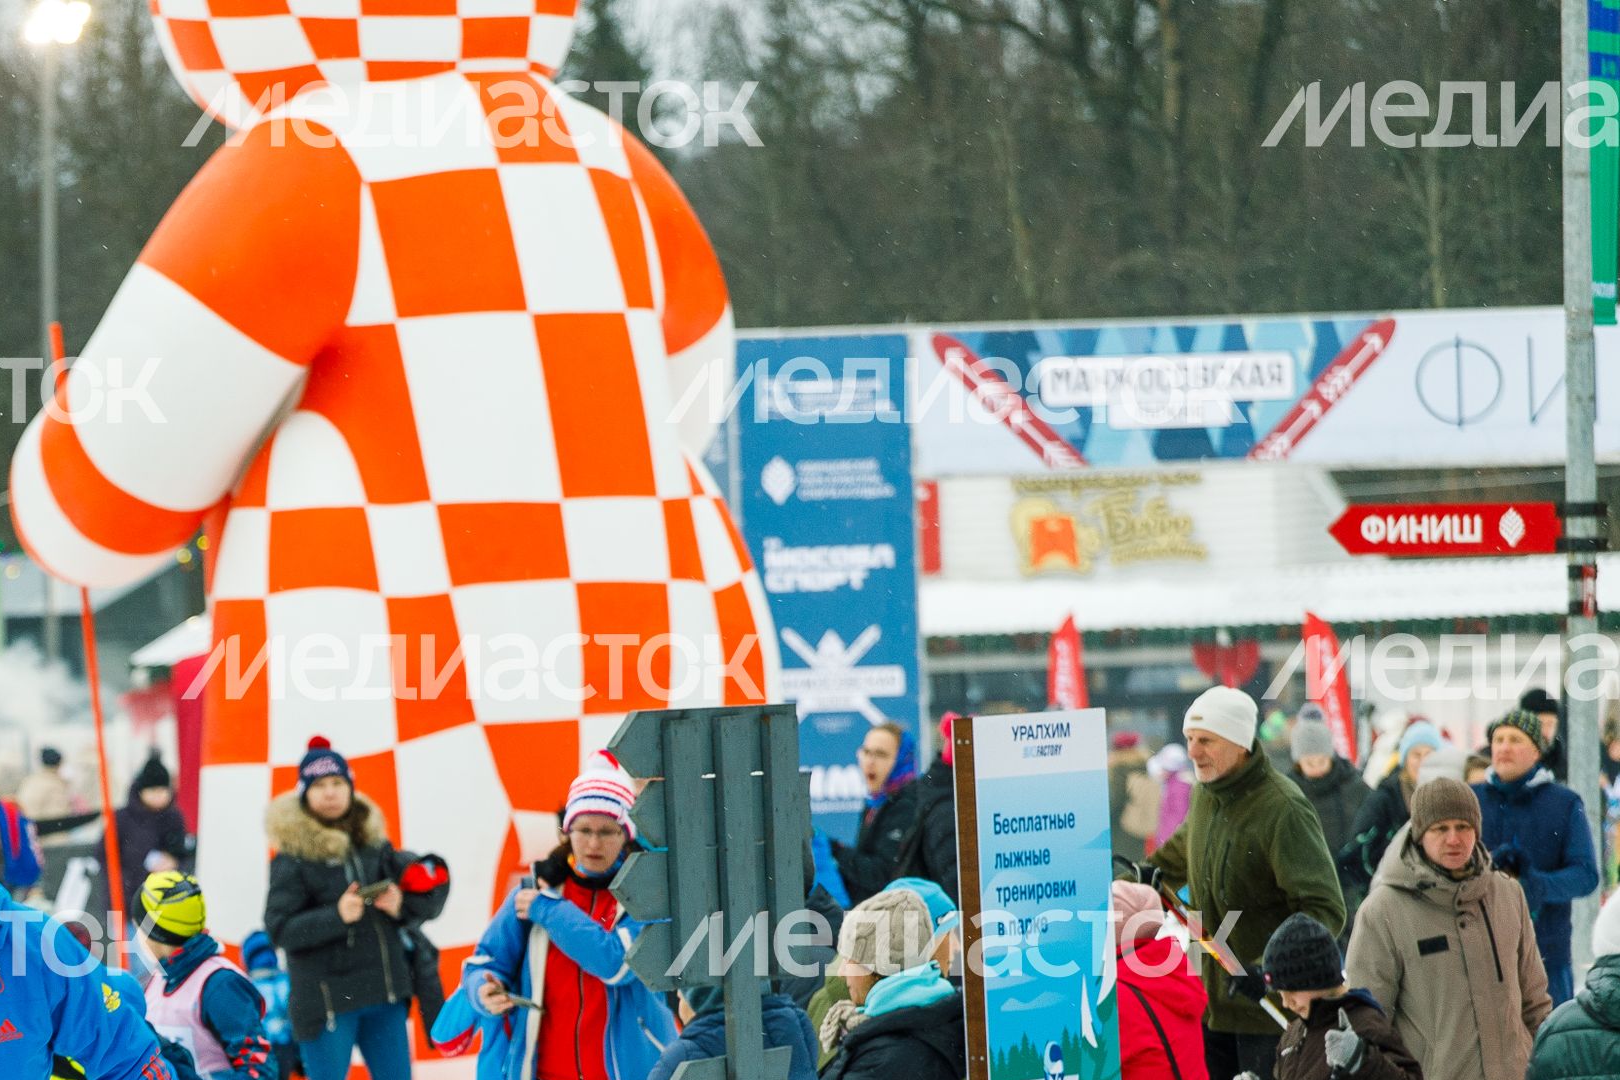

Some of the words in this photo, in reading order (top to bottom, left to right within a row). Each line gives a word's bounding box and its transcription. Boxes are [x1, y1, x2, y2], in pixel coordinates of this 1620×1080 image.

[1359, 514, 1483, 544] ФИНИШ
[1011, 721, 1071, 742] УРАЛХИМ
[993, 811, 1076, 836] Бесплатные
[994, 847, 1051, 870] лыжные
[996, 878, 1077, 908] тренировки
[997, 920, 1005, 936] в
[1008, 915, 1049, 940] парке
